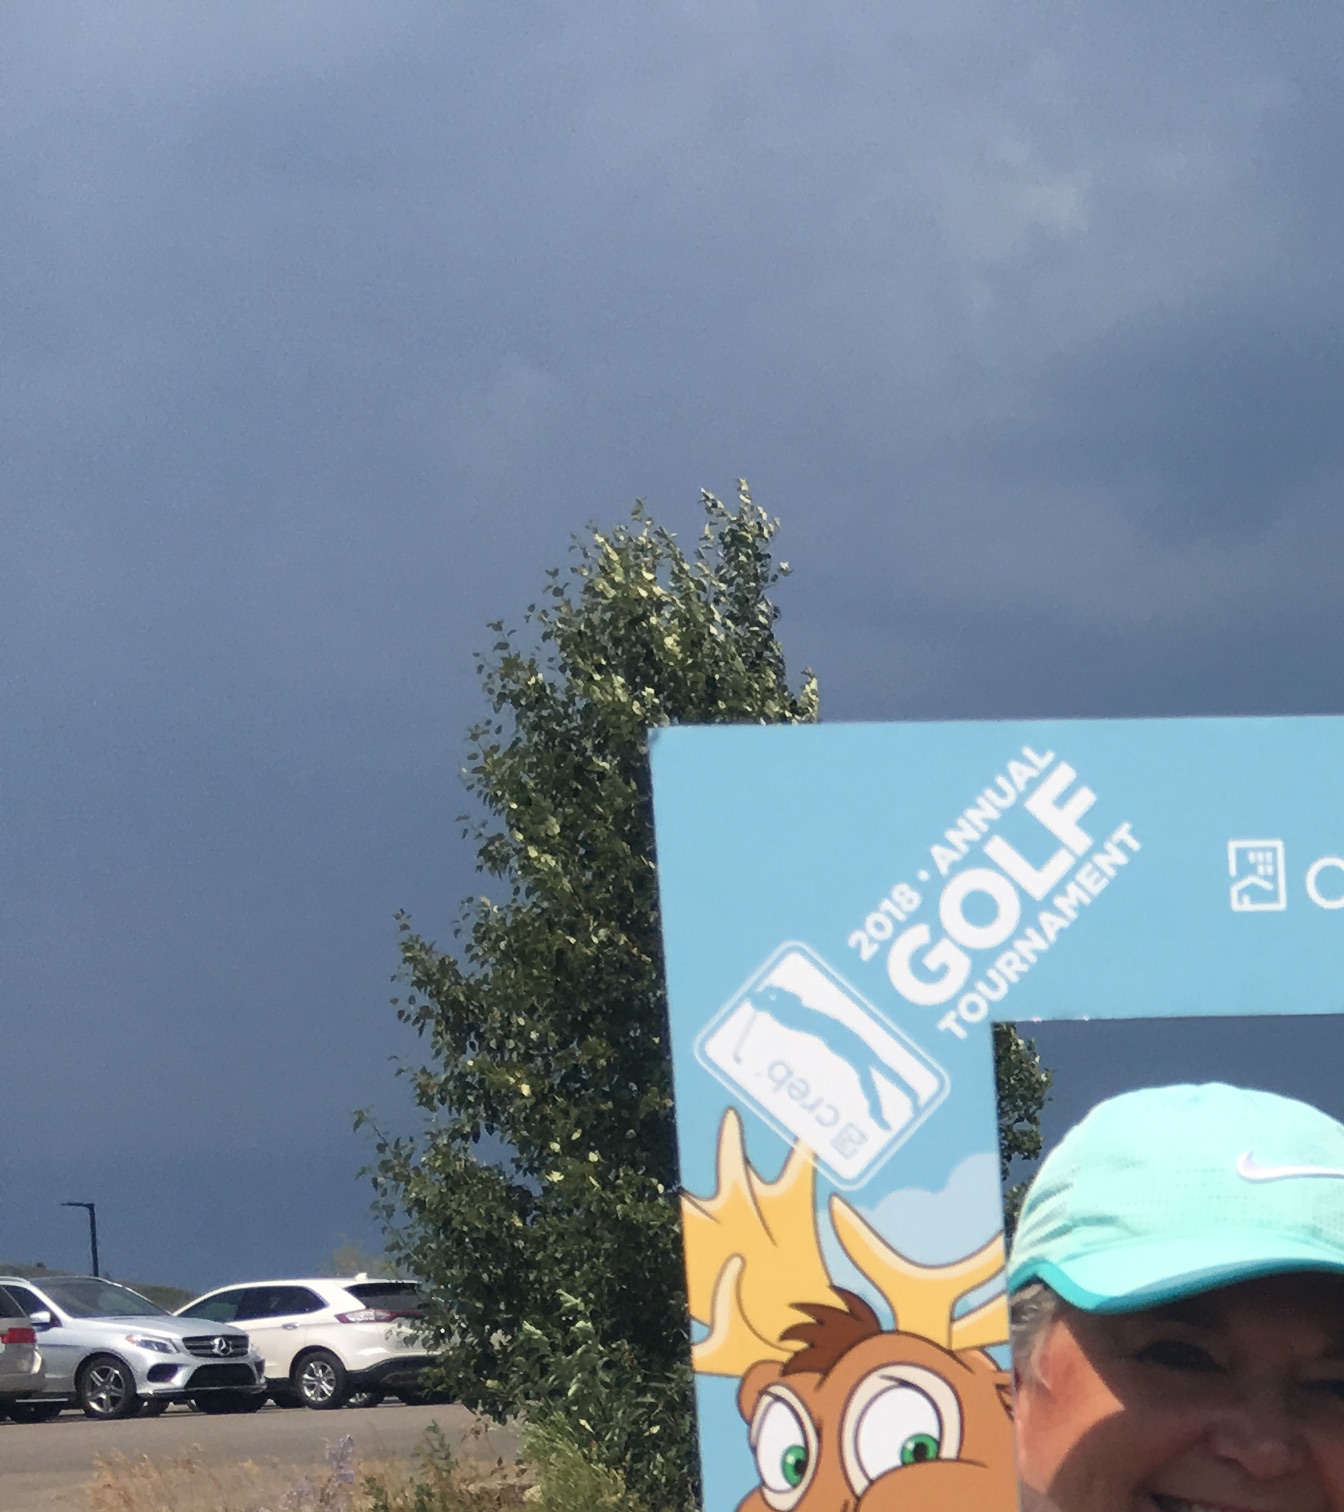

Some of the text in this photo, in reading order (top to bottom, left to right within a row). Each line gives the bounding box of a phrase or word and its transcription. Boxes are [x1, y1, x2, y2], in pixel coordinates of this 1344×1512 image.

[846, 744, 1056, 962] 2018 ANNUAL
[886, 761, 1098, 1007] GOLF
[936, 821, 1143, 1040] TOURNAMENT
[767, 1059, 840, 1128] creb
